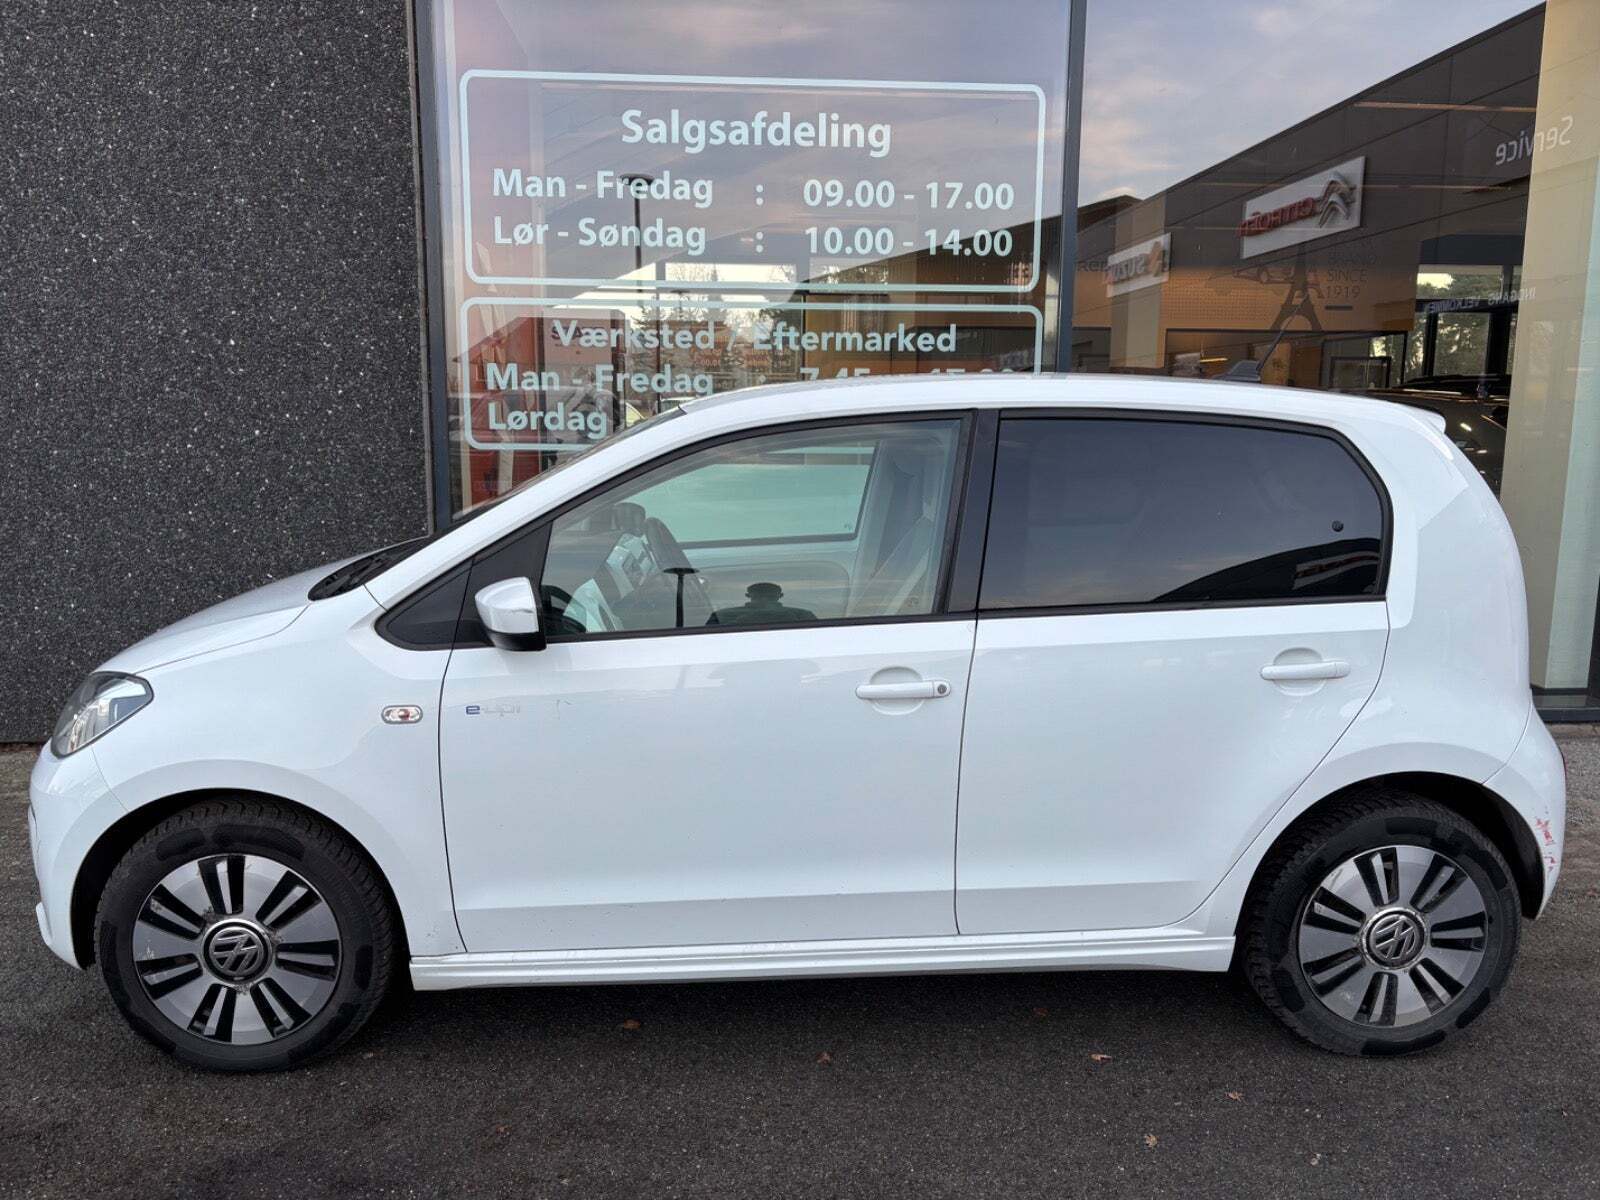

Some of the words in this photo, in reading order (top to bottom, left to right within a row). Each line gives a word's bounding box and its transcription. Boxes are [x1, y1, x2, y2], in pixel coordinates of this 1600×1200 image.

[621, 109, 892, 158] Salgsafdeling
[493, 168, 566, 198] Man
[596, 170, 713, 208] Fredag
[803, 179, 895, 208] 09.00
[925, 182, 1014, 210] 17.00
[494, 215, 549, 246] Lør
[578, 217, 706, 256] Søndag
[804, 227, 895, 255] 10.00
[924, 229, 1013, 256] 14.00
[553, 319, 715, 349] Værksted
[752, 320, 957, 352] Eftermarked
[486, 362, 560, 390] Man
[595, 363, 713, 398] Fredag
[488, 401, 608, 439] Lørdag
